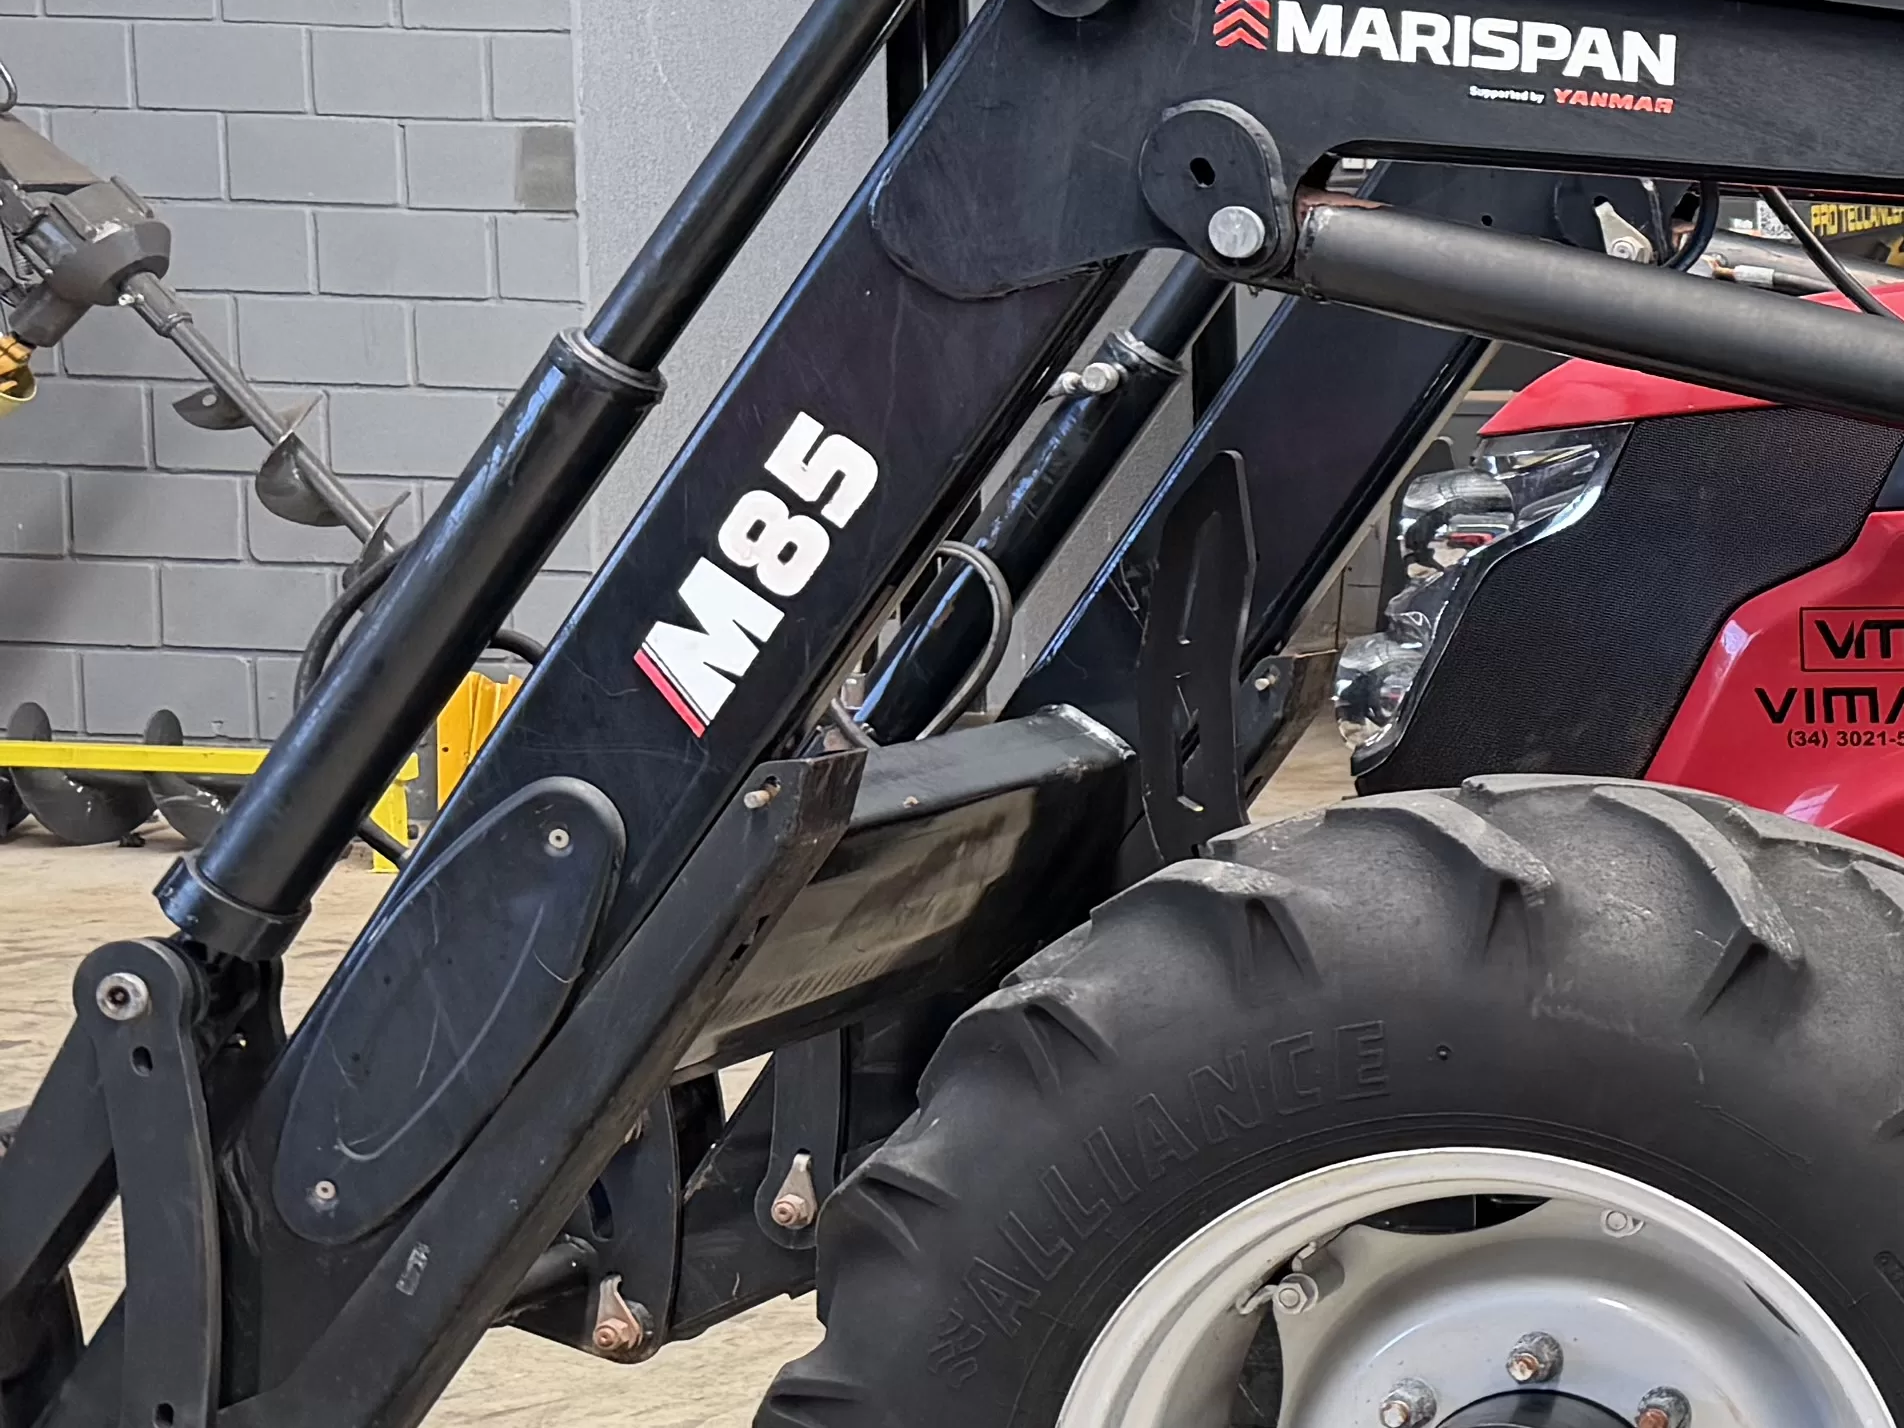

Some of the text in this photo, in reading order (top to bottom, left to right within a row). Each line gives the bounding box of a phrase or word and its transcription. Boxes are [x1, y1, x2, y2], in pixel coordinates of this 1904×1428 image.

[1277, 0, 1677, 86] MARISPAN
[1554, 88, 1674, 114] YANMAR
[636, 412, 878, 732] M85
[1787, 730, 1829, 749] (34)
[963, 1019, 1392, 1339] ALLIANCE
